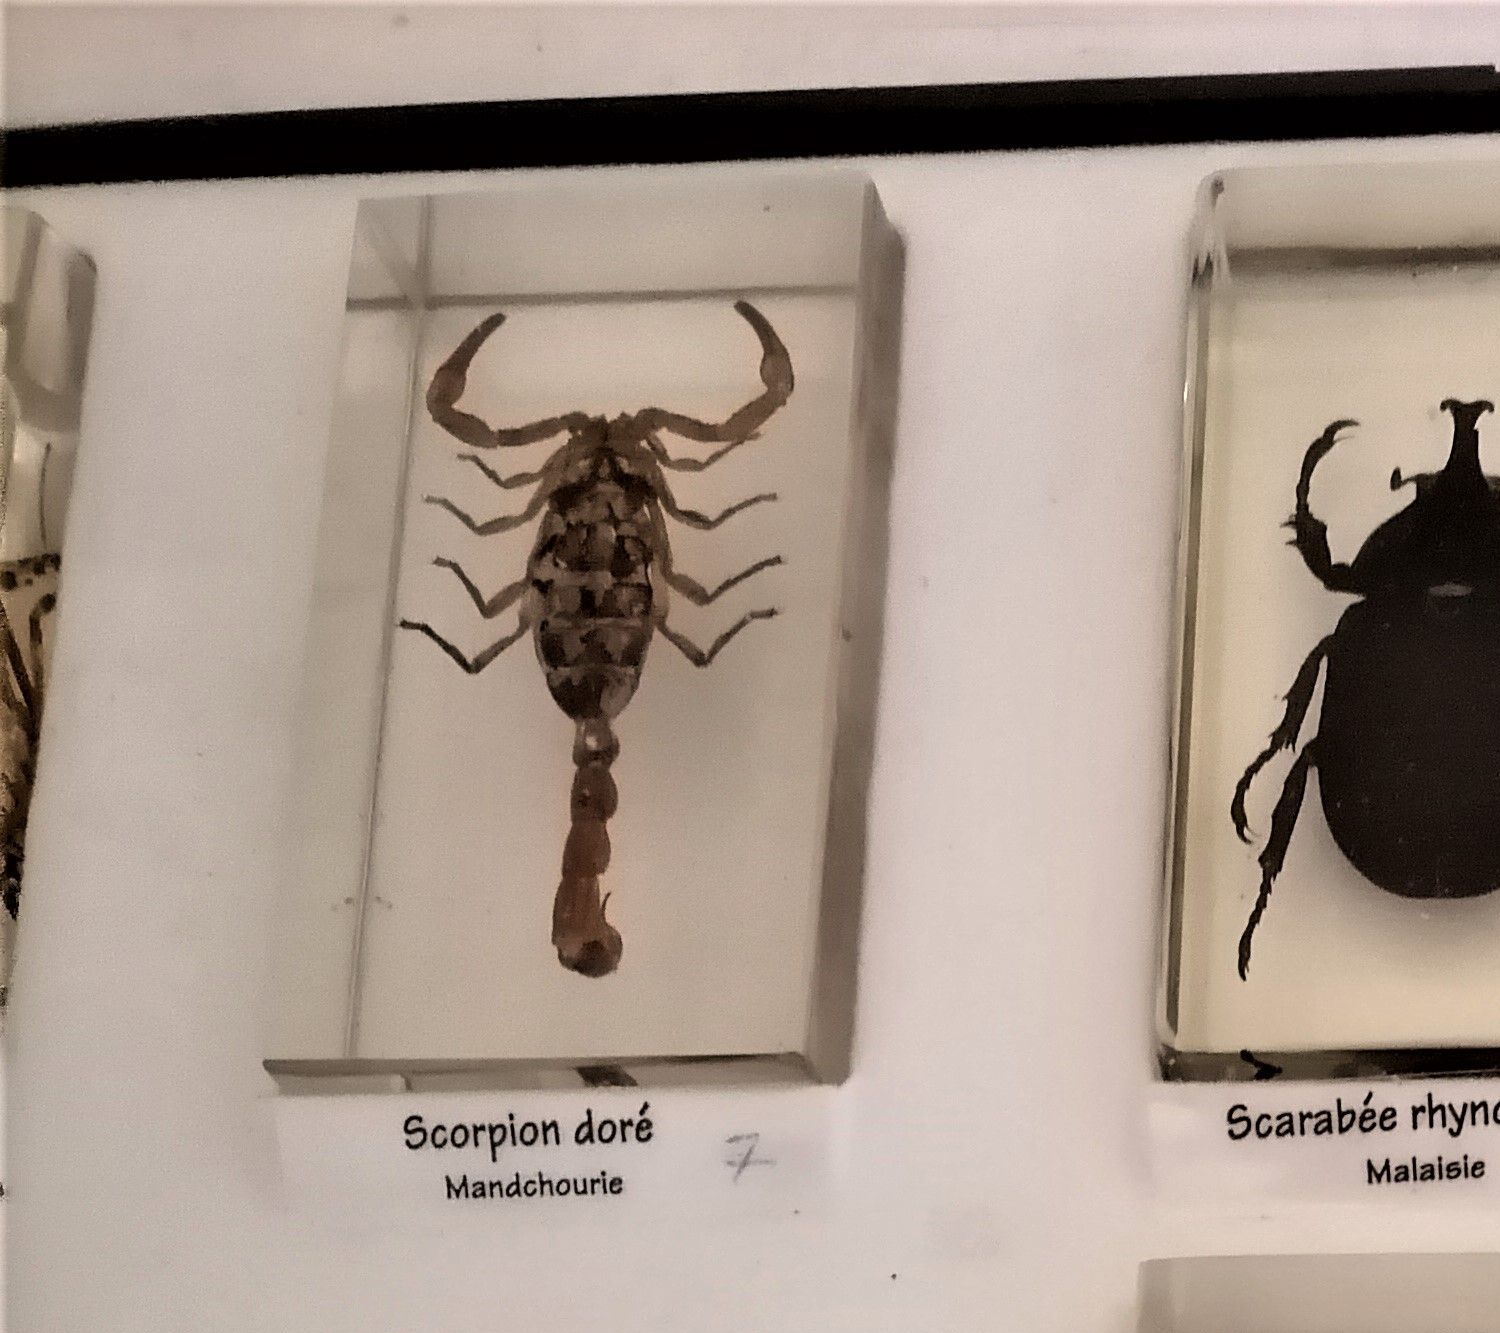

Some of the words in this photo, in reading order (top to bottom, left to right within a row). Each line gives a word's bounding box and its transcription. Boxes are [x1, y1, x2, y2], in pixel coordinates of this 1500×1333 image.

[403, 1114, 561, 1162] Scorpion
[574, 1102, 654, 1145] doré
[1226, 1091, 1398, 1141] Scarabée
[445, 1170, 624, 1200] Mandchourie
[1367, 1155, 1486, 1185] Malaisie
